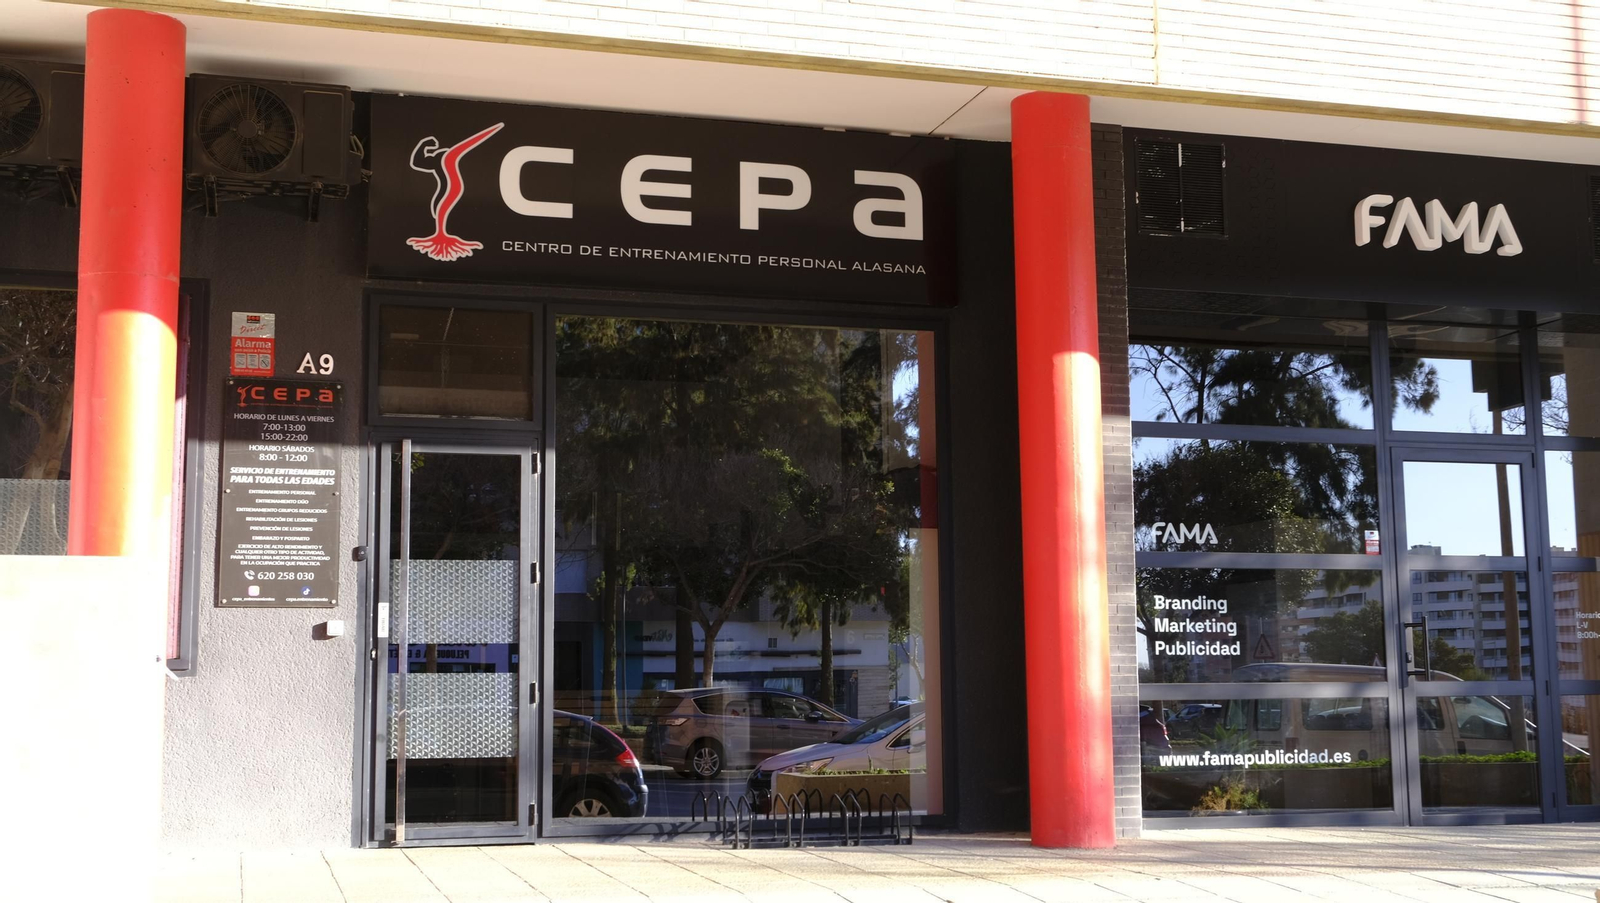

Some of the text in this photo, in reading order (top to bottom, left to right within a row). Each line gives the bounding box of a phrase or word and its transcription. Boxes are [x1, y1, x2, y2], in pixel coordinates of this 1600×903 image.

[1354, 193, 1523, 257] FAMA
[502, 240, 926, 275] CENTRO DE ENTRENAMIENTO PERSONAL ALASANA
[235, 338, 272, 348] Alarma
[296, 352, 334, 376] A9
[261, 432, 308, 441] 15:00-22:00
[263, 423, 306, 431] 7:00-13:00
[230, 475, 253, 483] PARA
[255, 476, 283, 484] TODAS
[301, 477, 335, 485] EDADES
[1152, 522, 1219, 545] FAMA
[1153, 594, 1228, 614] Branding
[1154, 617, 1237, 637] Marketing
[1155, 640, 1241, 656] Publicidad
[1159, 749, 1351, 768] www.famapublicidad.es
